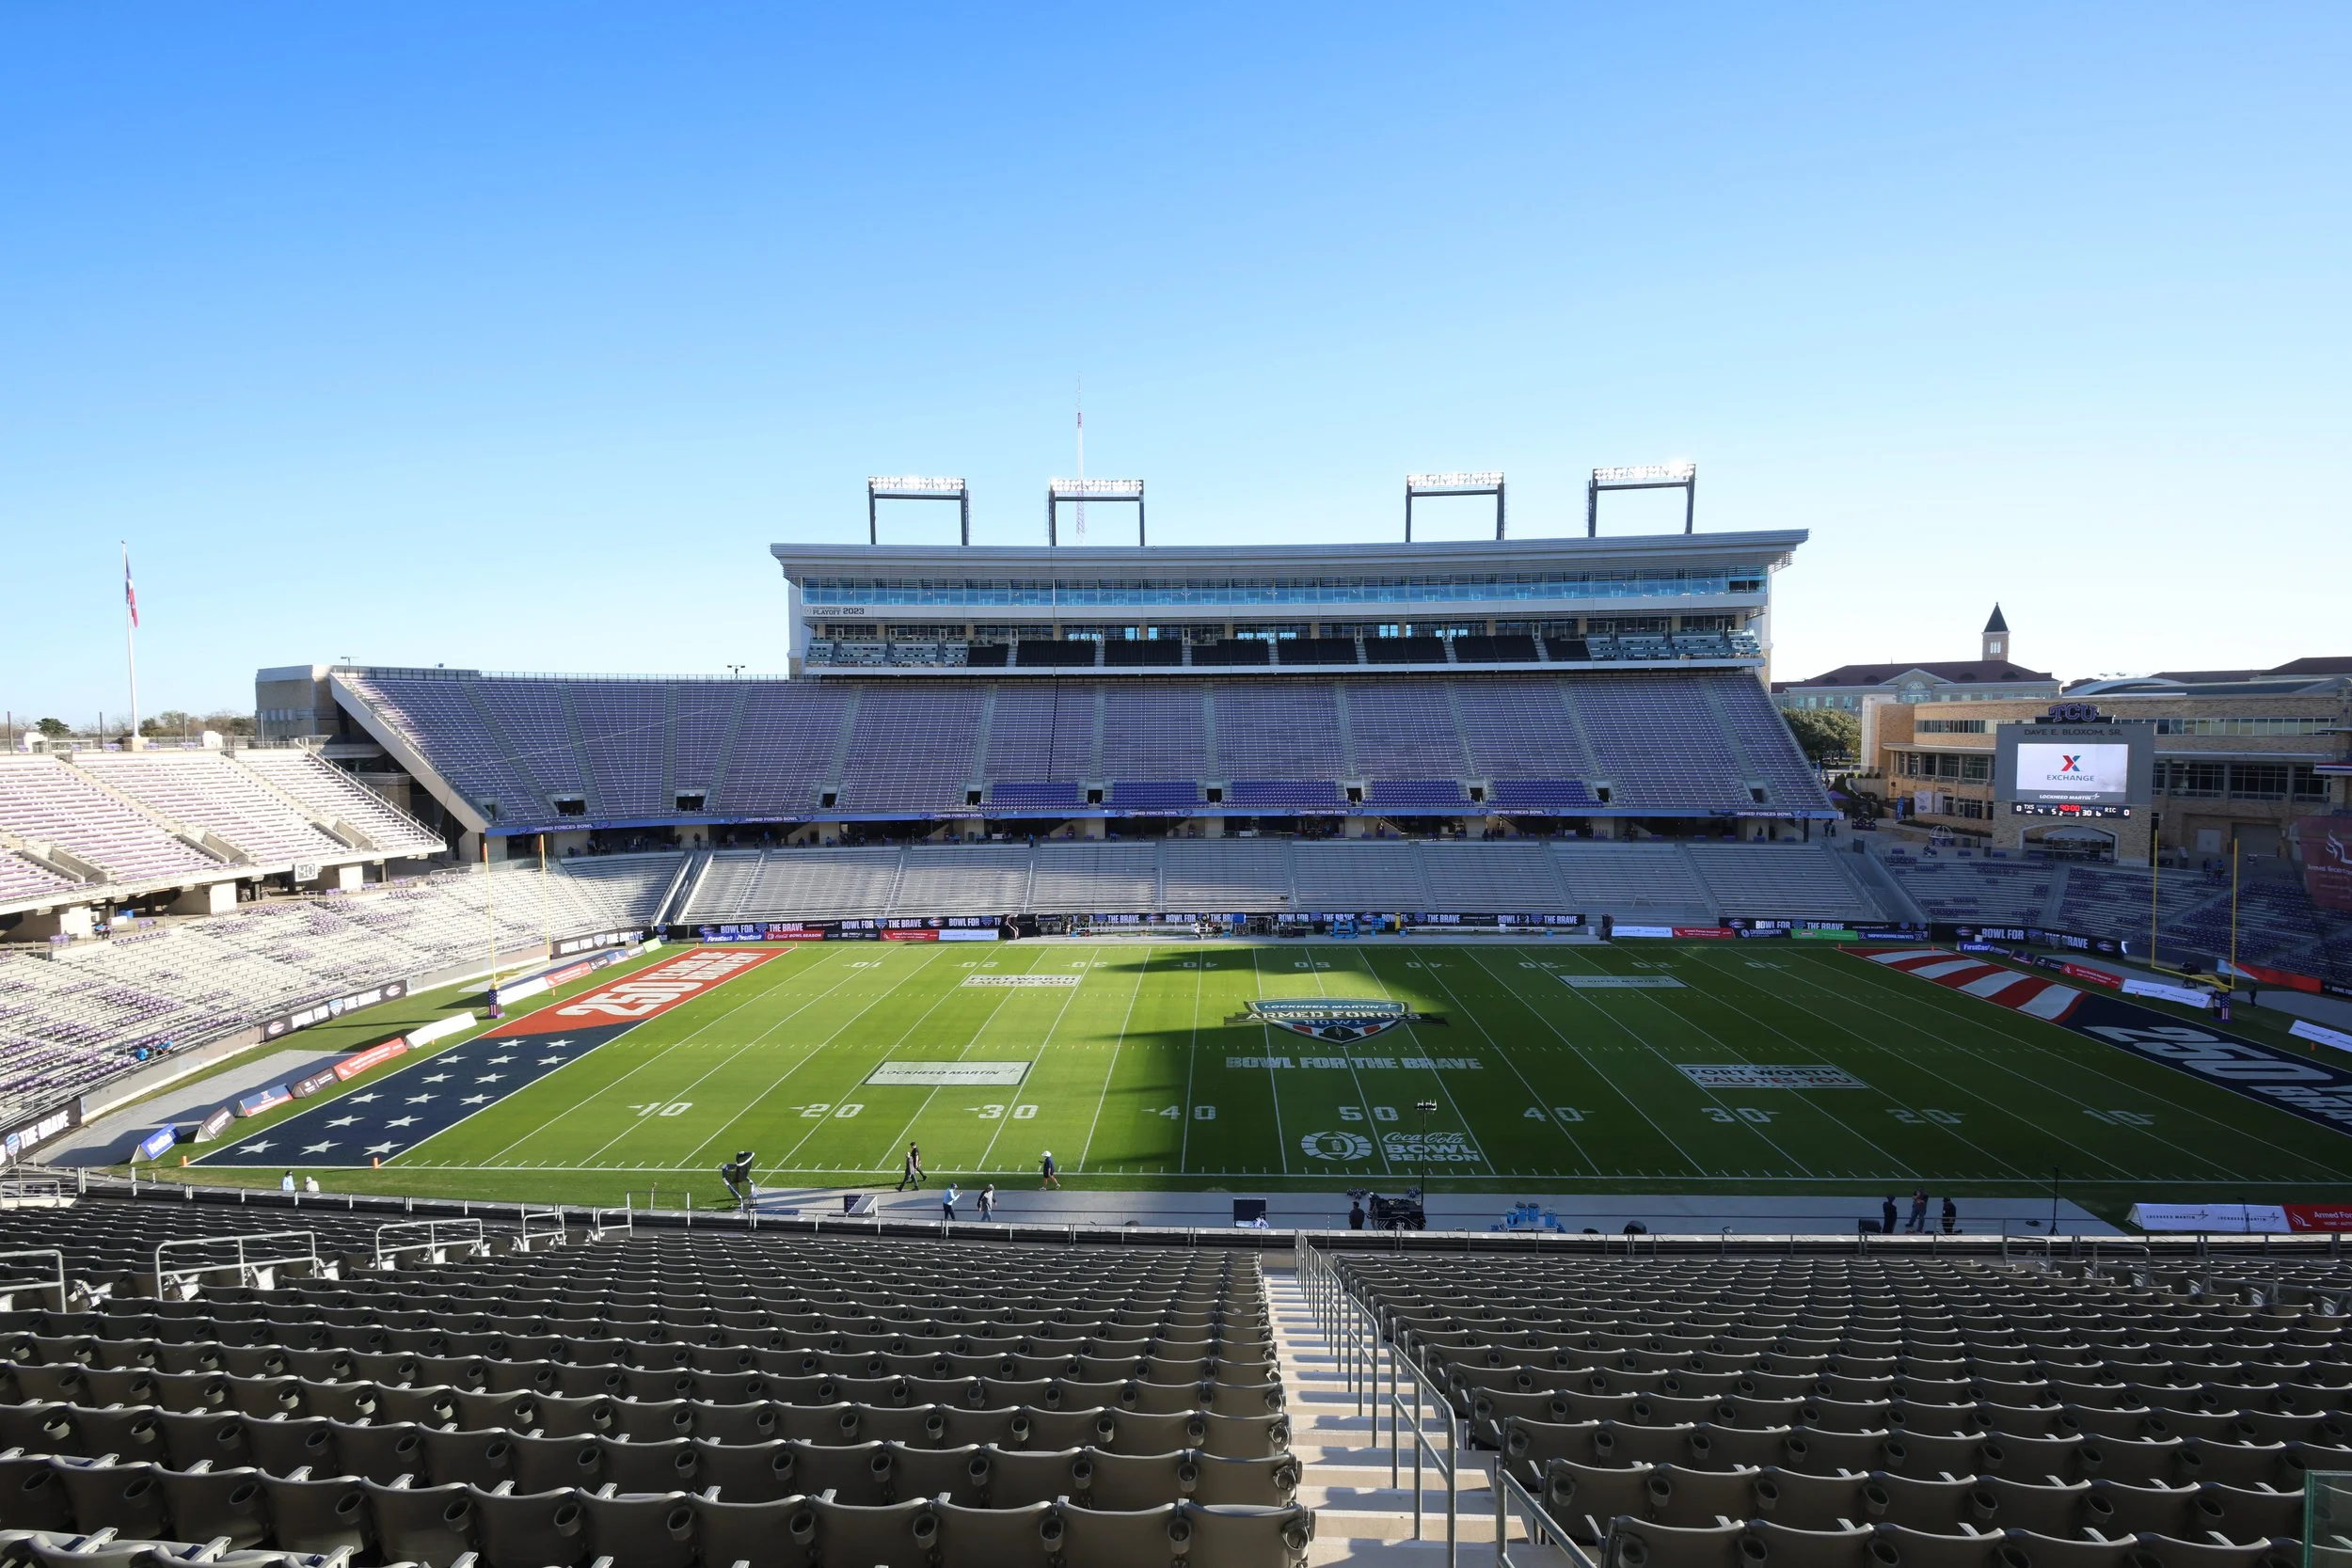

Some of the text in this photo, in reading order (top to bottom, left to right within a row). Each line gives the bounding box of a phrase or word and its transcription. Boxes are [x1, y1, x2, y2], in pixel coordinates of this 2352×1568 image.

[2049, 703, 2098, 722] TCU
[298, 863, 315, 877] 40
[948, 918, 980, 927] BOWL FOR
[1107, 914, 1139, 923] THE BRAVE
[1166, 914, 1196, 923] BOWL FOR
[1210, 913, 1223, 922] THE
[1278, 913, 1295, 923] BOWL
[1323, 913, 1355, 922] THE BRAVE
[1426, 914, 1439, 923] THE
[1439, 914, 1460, 923] BRAVE
[1498, 915, 1517, 924] BOWL
[1544, 915, 1578, 925] THE BRAVE
[721, 924, 754, 933] BOWL FOR
[769, 924, 782, 932] THE
[782, 923, 803, 932] BRAVE
[841, 921, 860, 929] BOWL
[861, 920, 874, 928] FOR
[888, 919, 922, 928] THE BRAVE
[1756, 920, 1790, 929] BOWL FOR
[1982, 927, 2025, 941] BOWL FOR
[554, 982, 704, 1016] 250
[1246, 1010, 1422, 1021] ARMED FORCES
[2083, 1025, 2334, 1080] 250
[1226, 1056, 1484, 1069] BOWL FOR THE BRAVE
[637, 1102, 692, 1117] 10
[800, 1103, 865, 1118] 20
[978, 1104, 1039, 1118] 30
[1159, 1105, 1216, 1120] 40
[1339, 1106, 1399, 1121] 50
[1523, 1106, 1584, 1122] 40
[1701, 1108, 1772, 1123] 30
[1885, 1108, 1962, 1124] 20
[2082, 1110, 2154, 1125] 10
[19, 1125, 39, 1148] THE
[1385, 1144, 1477, 1154] BOWL
[1388, 1153, 1481, 1162] SEASON
